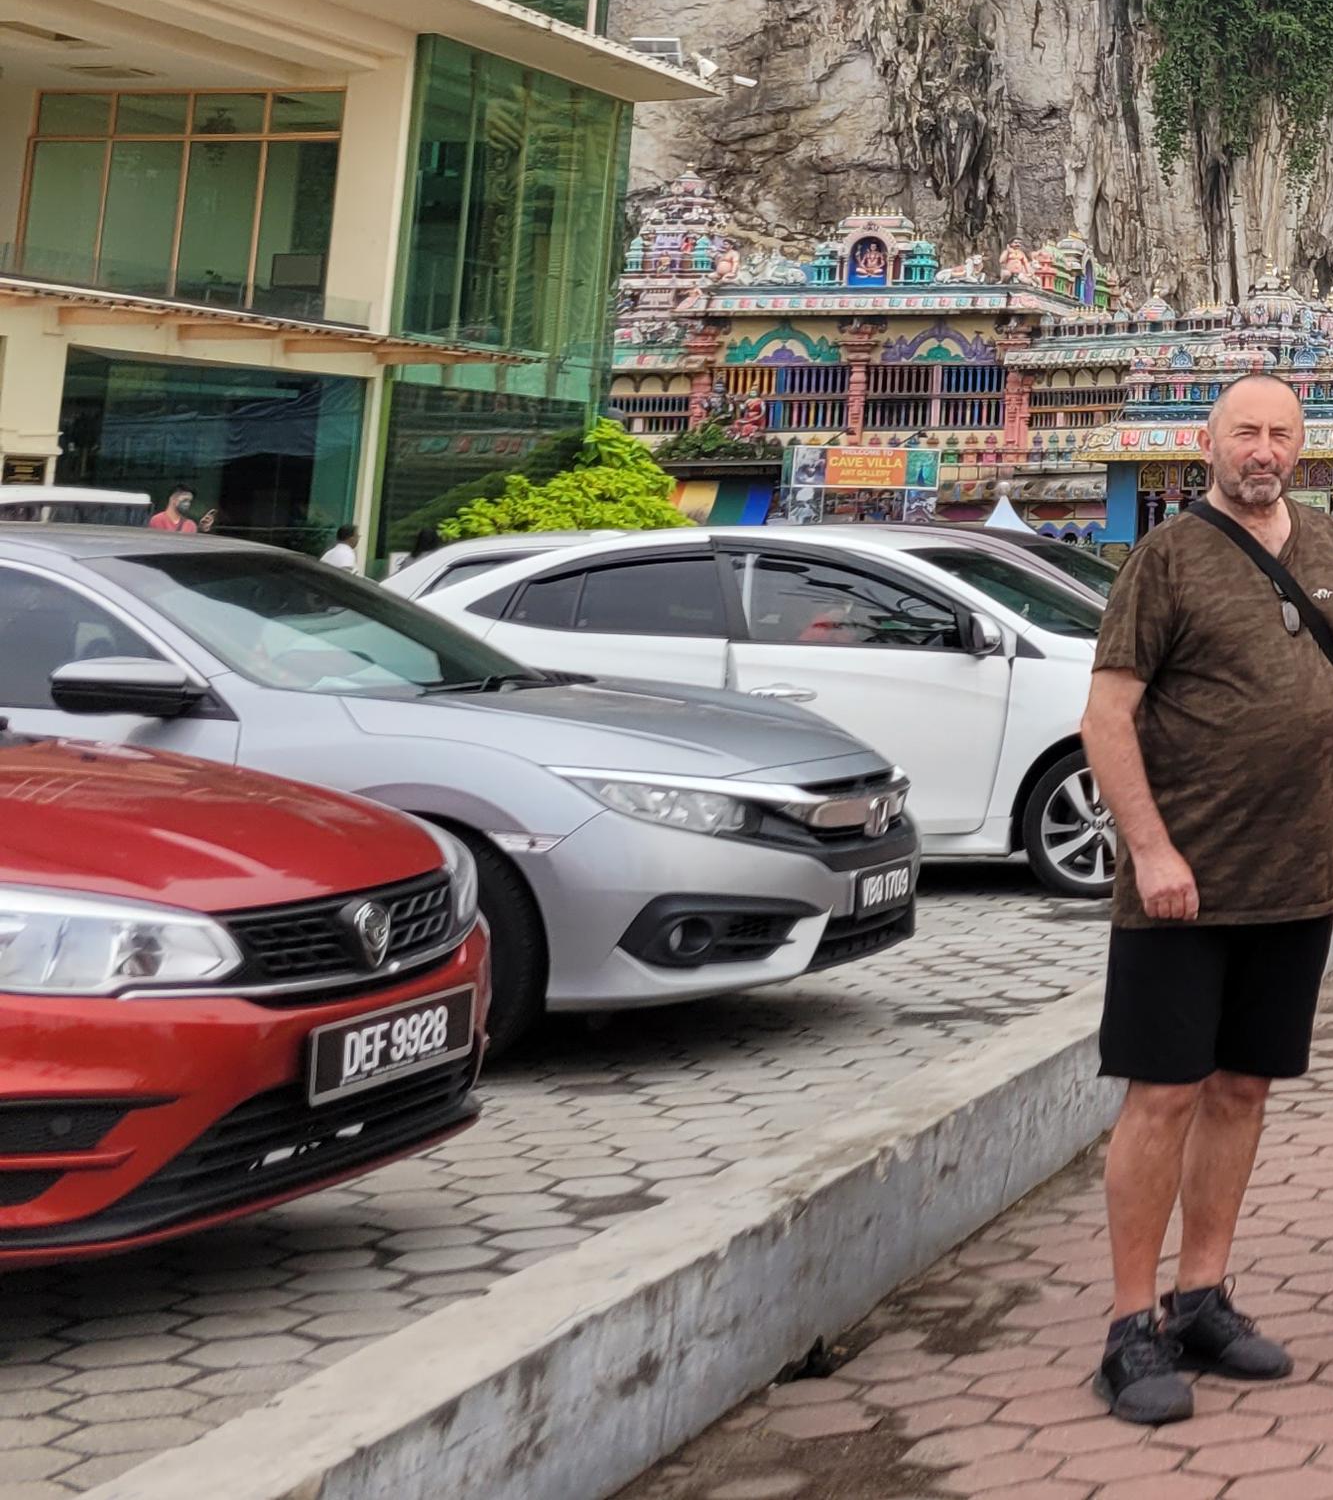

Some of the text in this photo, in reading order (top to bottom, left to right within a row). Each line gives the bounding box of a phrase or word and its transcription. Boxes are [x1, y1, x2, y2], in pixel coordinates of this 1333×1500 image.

[830, 457, 903, 468] CAVE VILLA
[343, 1022, 390, 1078] DEF
[390, 1005, 448, 1061] 9928
